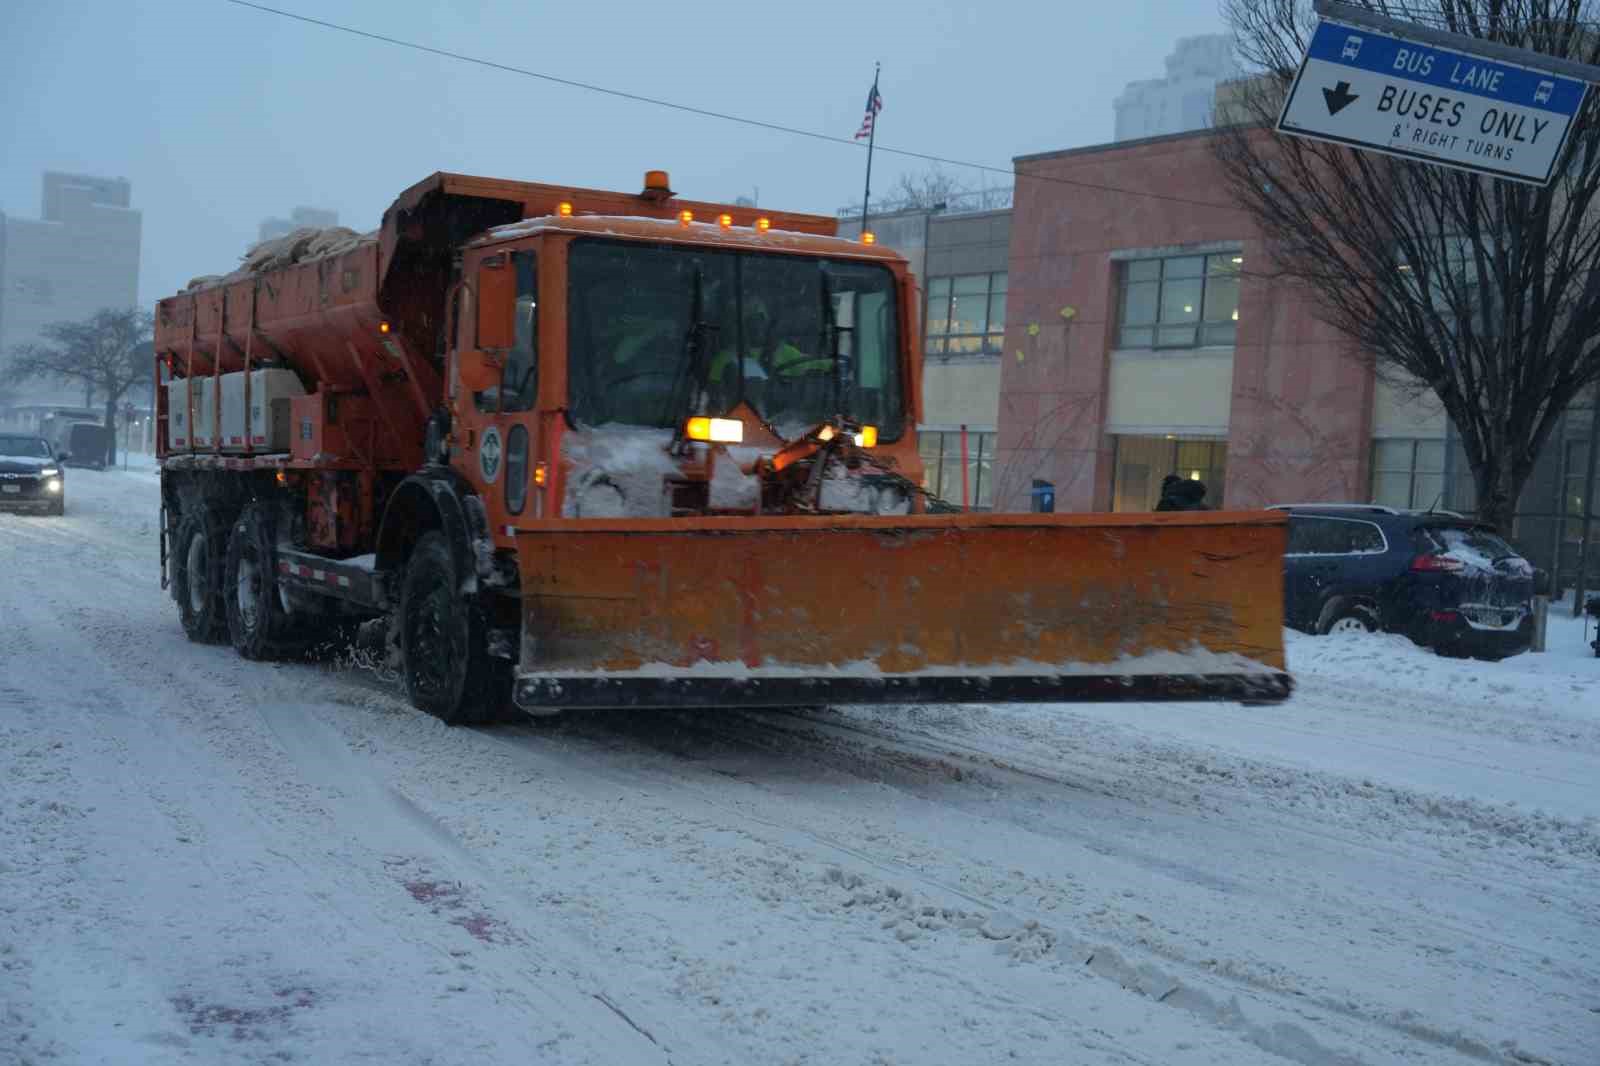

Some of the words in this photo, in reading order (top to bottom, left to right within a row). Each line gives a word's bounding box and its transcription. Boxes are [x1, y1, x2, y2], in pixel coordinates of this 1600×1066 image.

[1393, 49, 1433, 77] BUS
[1451, 61, 1504, 92] LANE
[1377, 85, 1465, 127] BUSES
[1480, 108, 1549, 145] ONLY
[1392, 124, 1401, 138] &
[1412, 127, 1458, 148] RIGHT
[1465, 139, 1514, 161] TURNS
